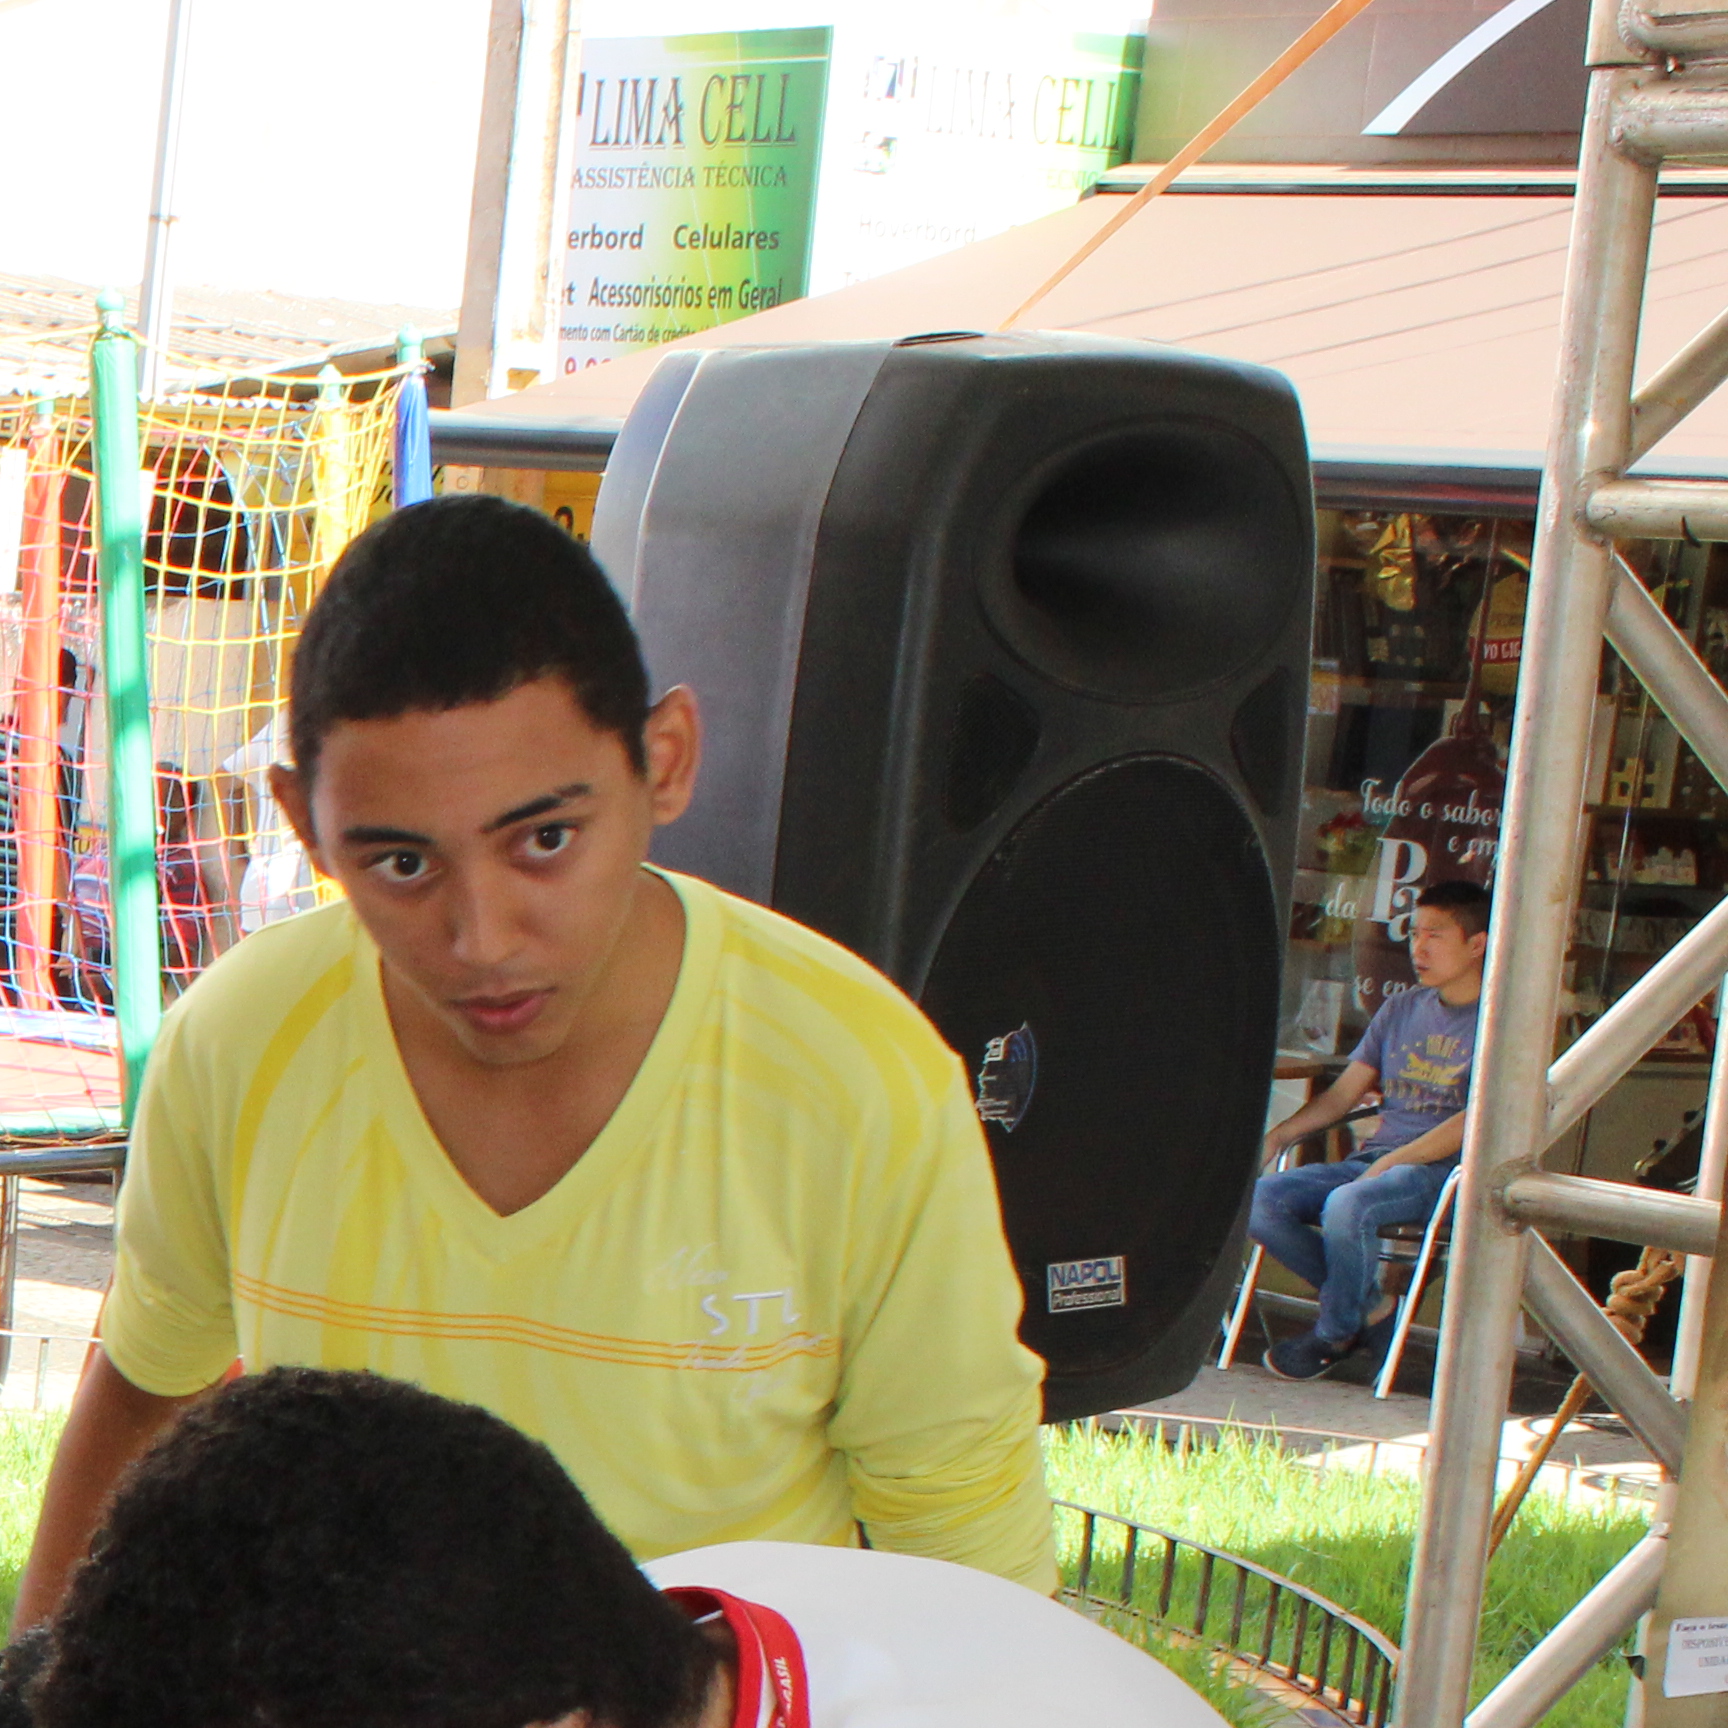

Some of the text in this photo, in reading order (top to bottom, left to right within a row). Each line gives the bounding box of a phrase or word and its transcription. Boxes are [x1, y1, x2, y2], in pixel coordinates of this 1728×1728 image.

[590, 73, 797, 148] LIMA CELL
[1034, 74, 1119, 150] CELL
[572, 160, 788, 189] ASSISTÊNCIA TÉCNICA
[673, 224, 780, 250] Celulares
[588, 275, 702, 309] Acessorisórios
[708, 286, 732, 309] em
[738, 277, 783, 310] Geral
[591, 327, 611, 341] com
[613, 324, 645, 342] Cartão
[647, 324, 659, 342] de
[1361, 777, 1411, 817] Todo
[1420, 803, 1433, 819] o
[1325, 882, 1357, 919] da
